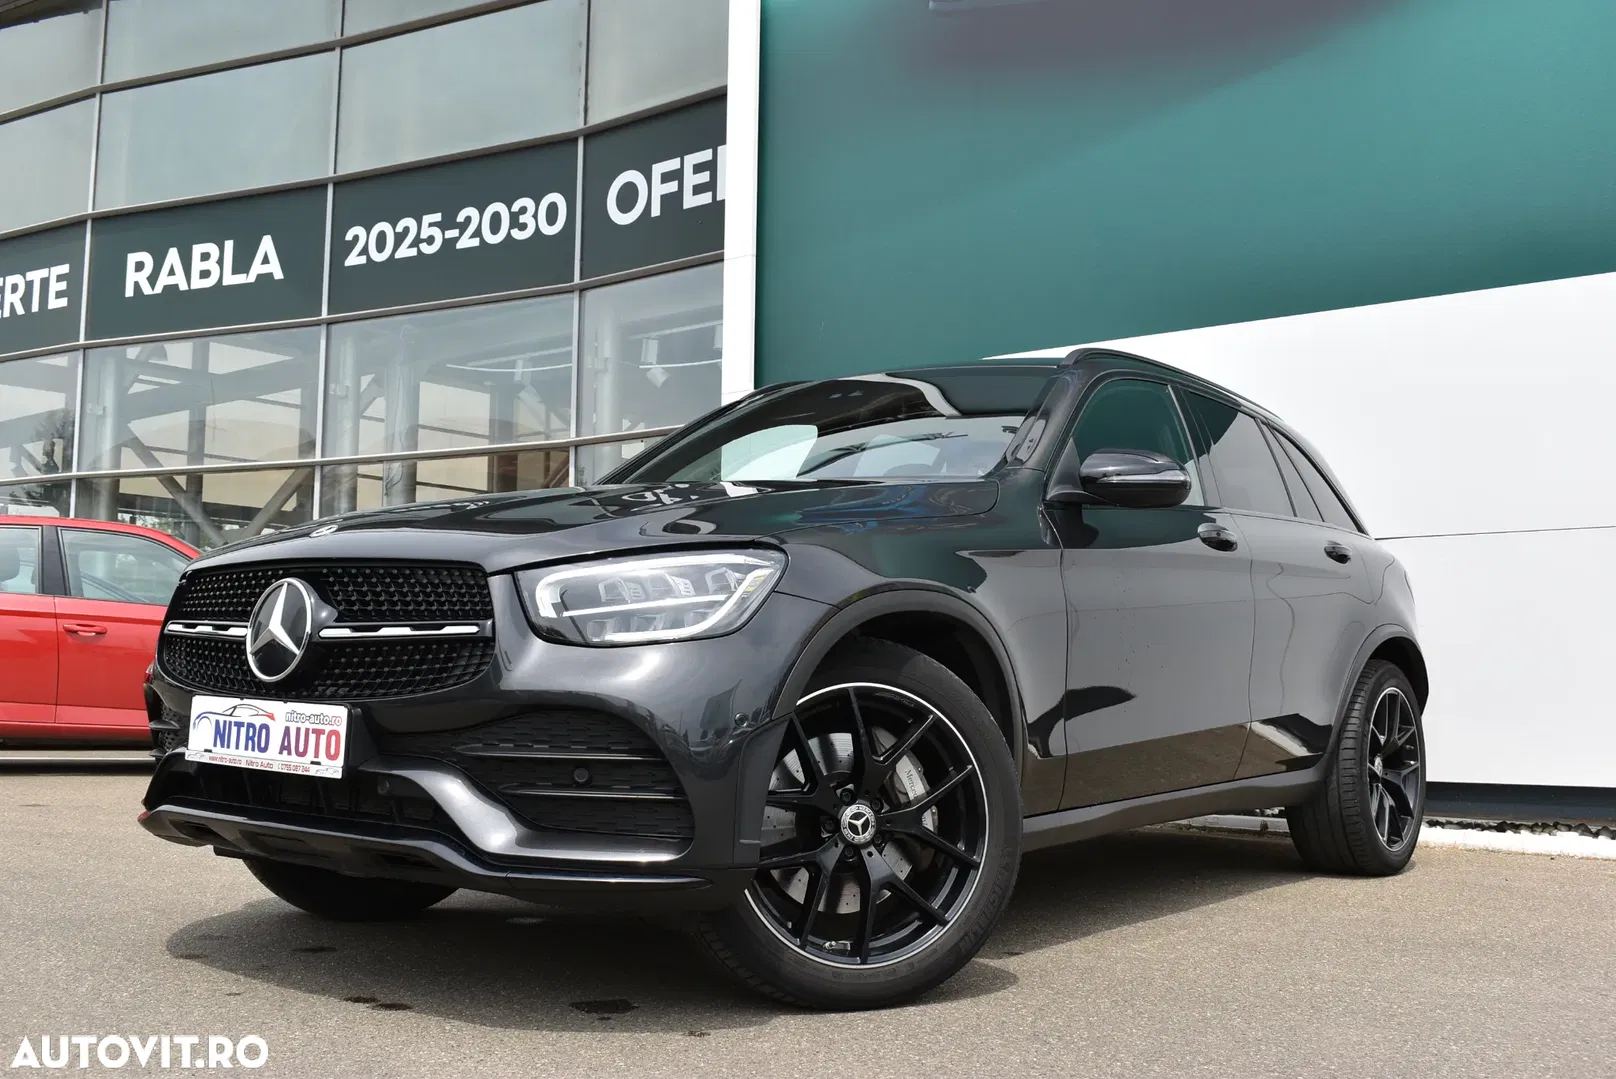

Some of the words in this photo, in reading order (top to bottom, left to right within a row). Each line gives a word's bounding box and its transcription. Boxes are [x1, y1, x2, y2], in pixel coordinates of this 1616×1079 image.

[0, 263, 70, 319] RTE
[125, 235, 284, 298] RABLA
[344, 192, 567, 267] 2025-2030
[285, 709, 342, 726] nitro-auto.ro
[213, 719, 271, 753] NITRO
[278, 725, 341, 761] AUTO
[245, 759, 259, 768] Nitro
[260, 761, 274, 770] Auto
